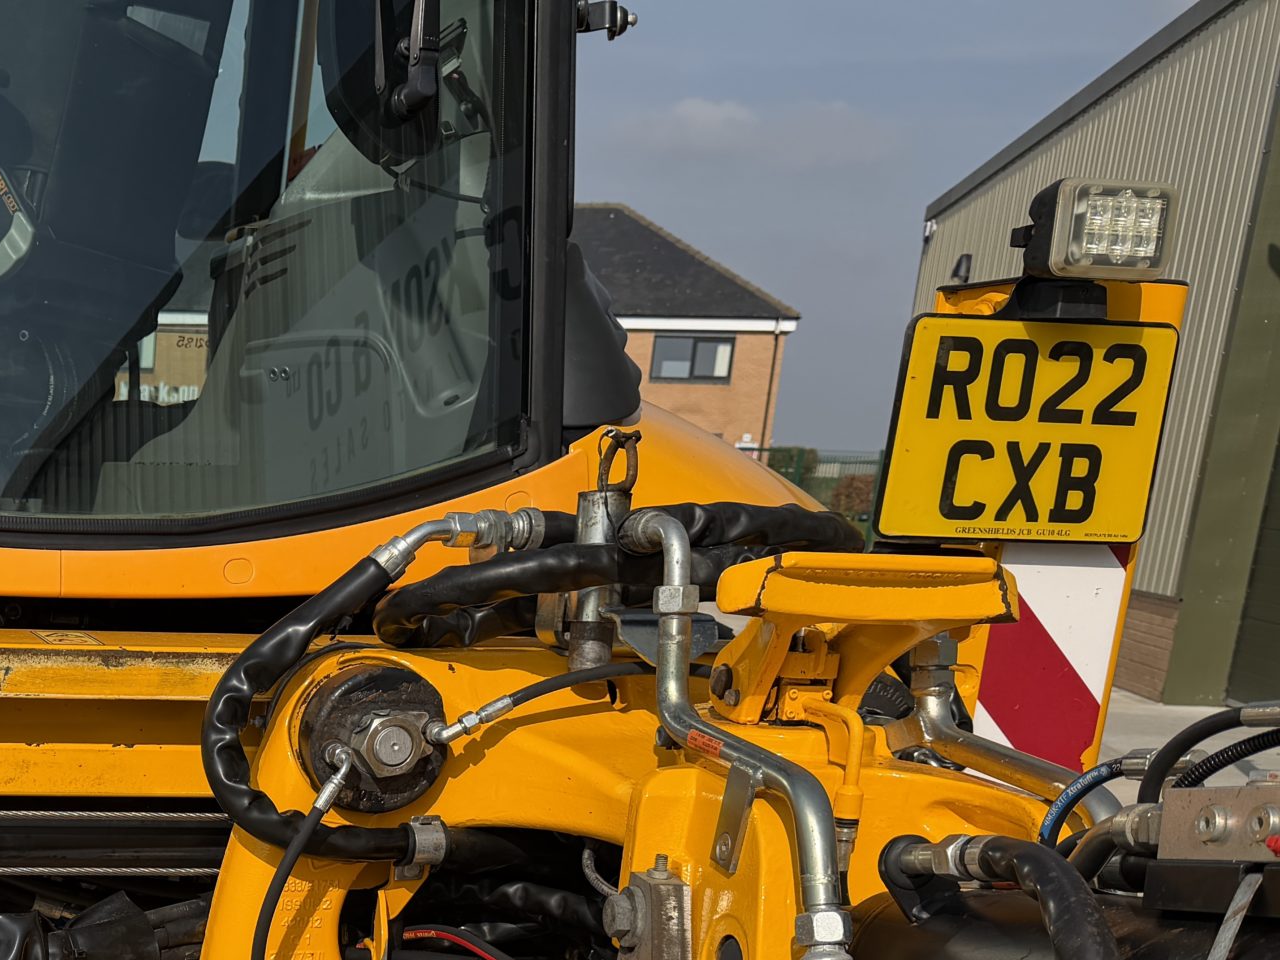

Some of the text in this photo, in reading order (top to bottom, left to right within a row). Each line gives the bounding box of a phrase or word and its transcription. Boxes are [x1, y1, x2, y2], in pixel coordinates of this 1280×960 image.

[925, 335, 1148, 427] RO22
[938, 439, 1103, 524] CXB
[954, 526, 1017, 537] GREENSHIELDS
[1017, 527, 1033, 537] JCB
